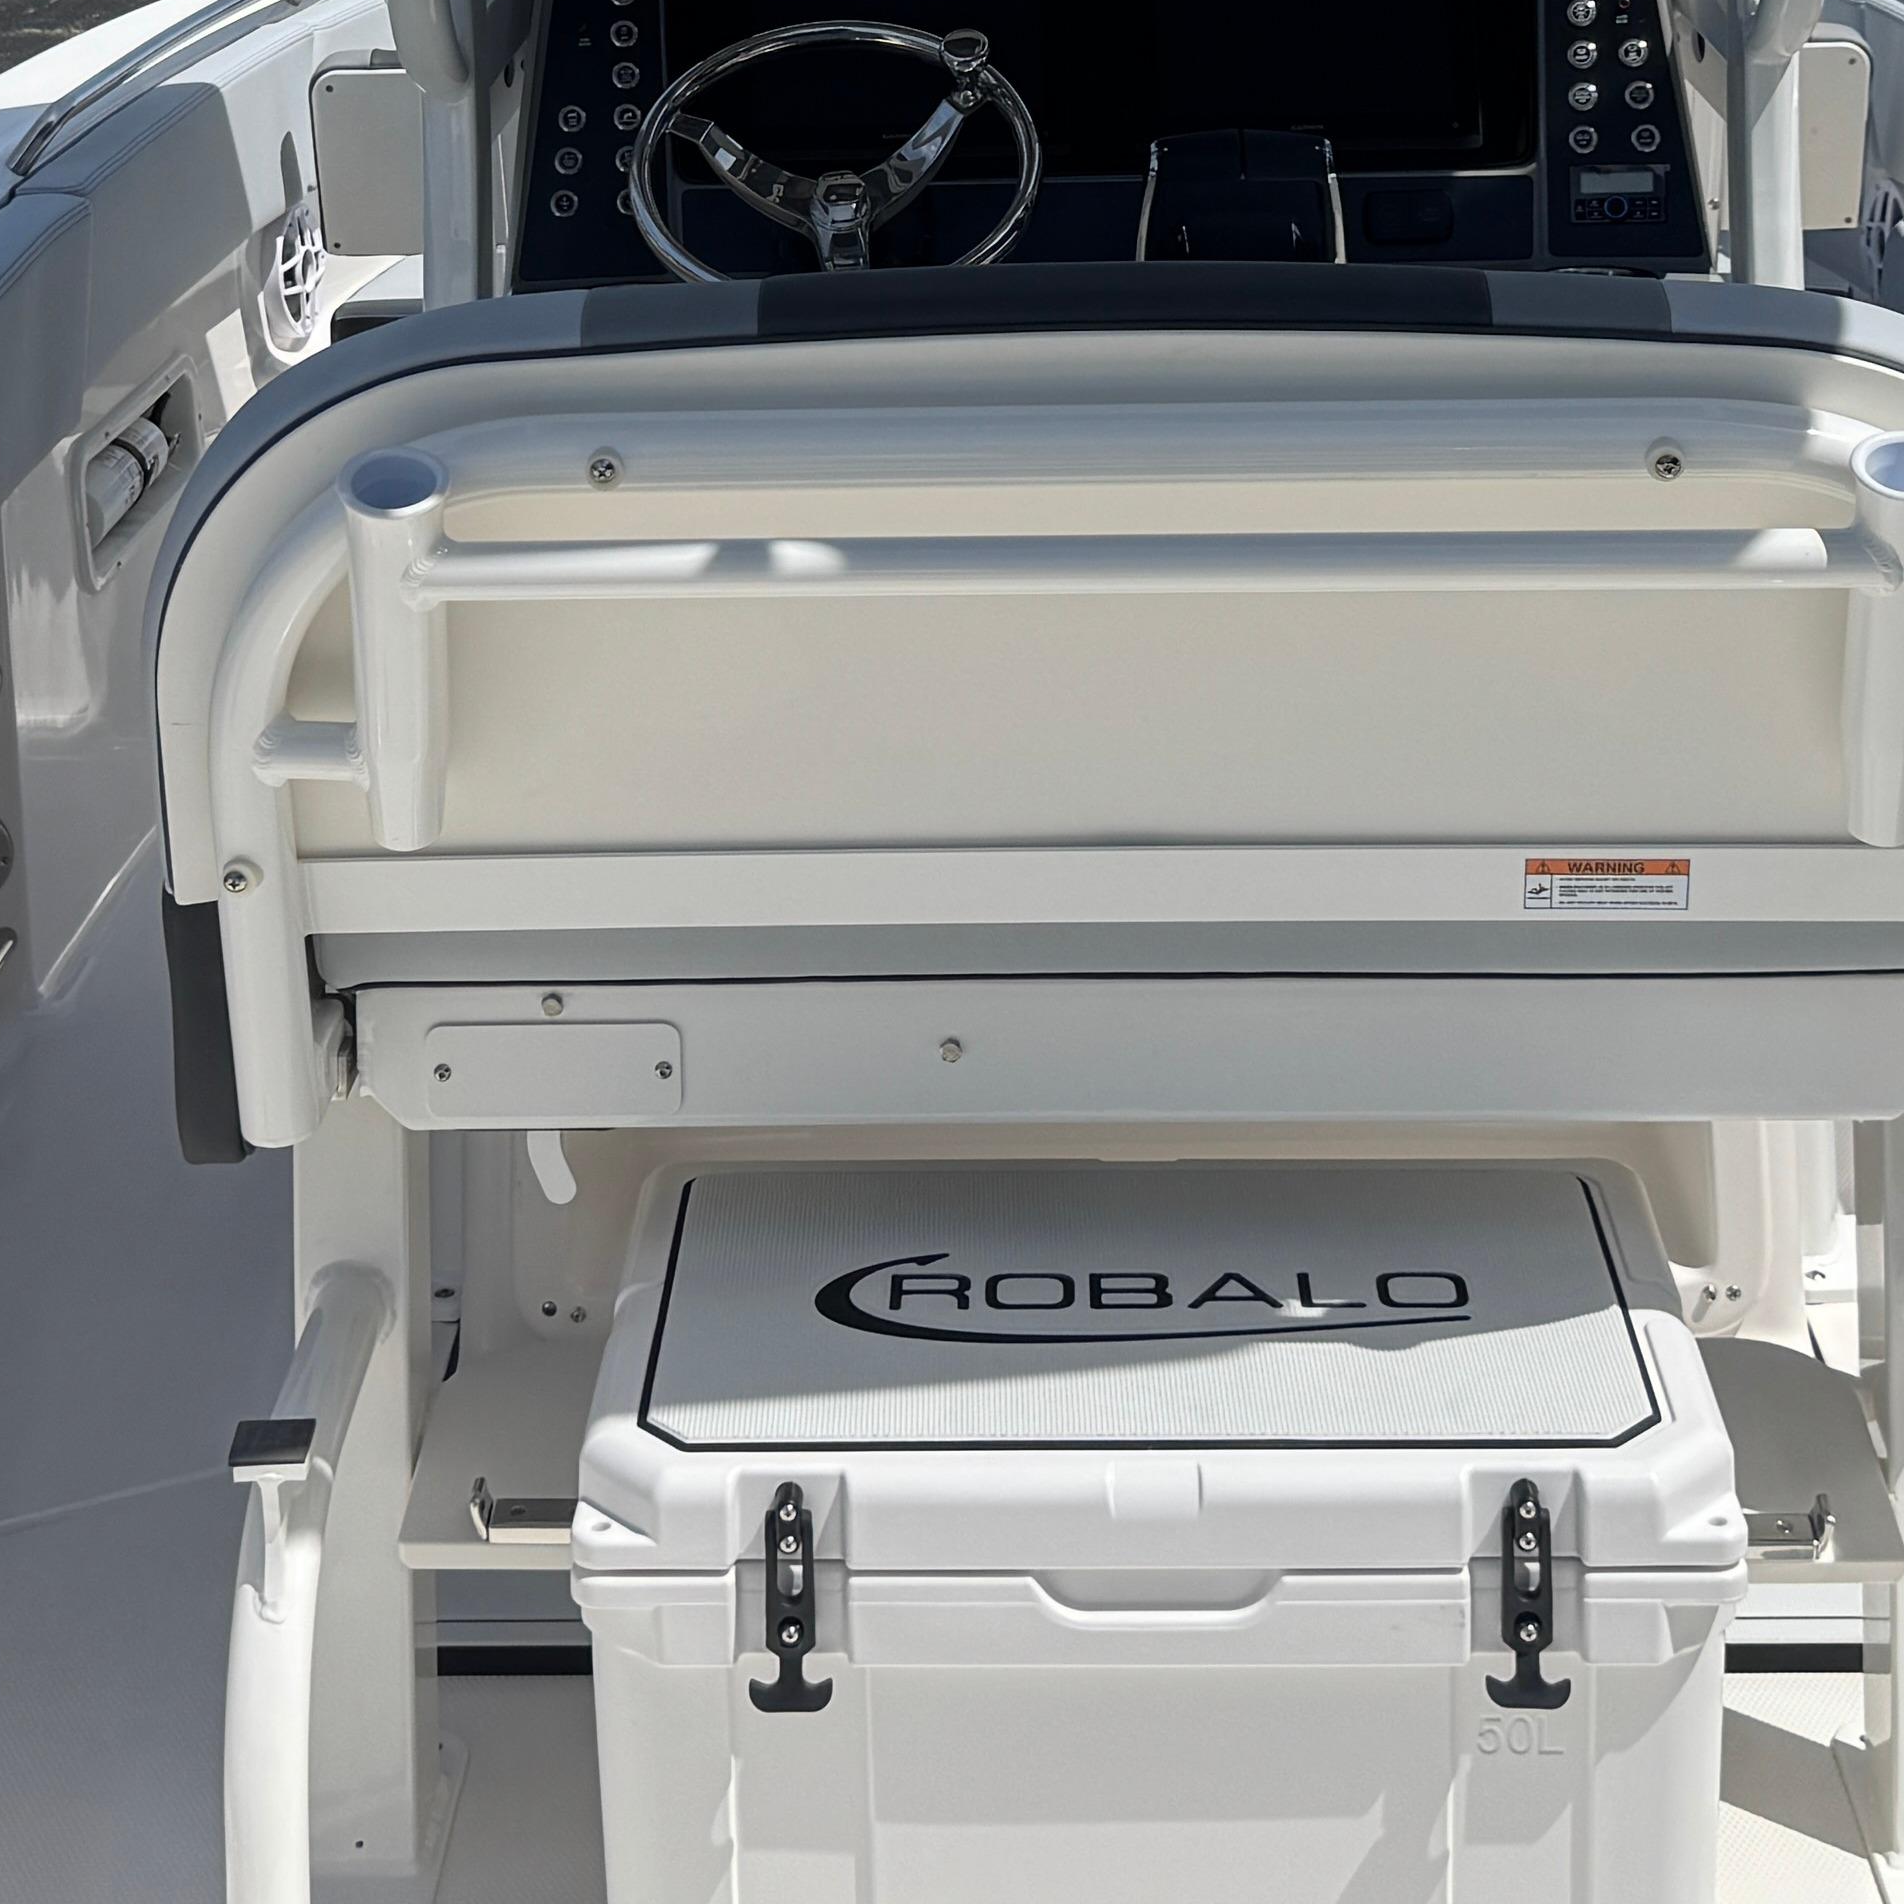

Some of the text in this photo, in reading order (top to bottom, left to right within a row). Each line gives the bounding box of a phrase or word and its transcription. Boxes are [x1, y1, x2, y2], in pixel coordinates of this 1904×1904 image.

[1567, 861, 1645, 874] WARNING
[889, 1271, 1471, 1310] ROBALO
[1477, 1716, 1564, 1756] 50L
